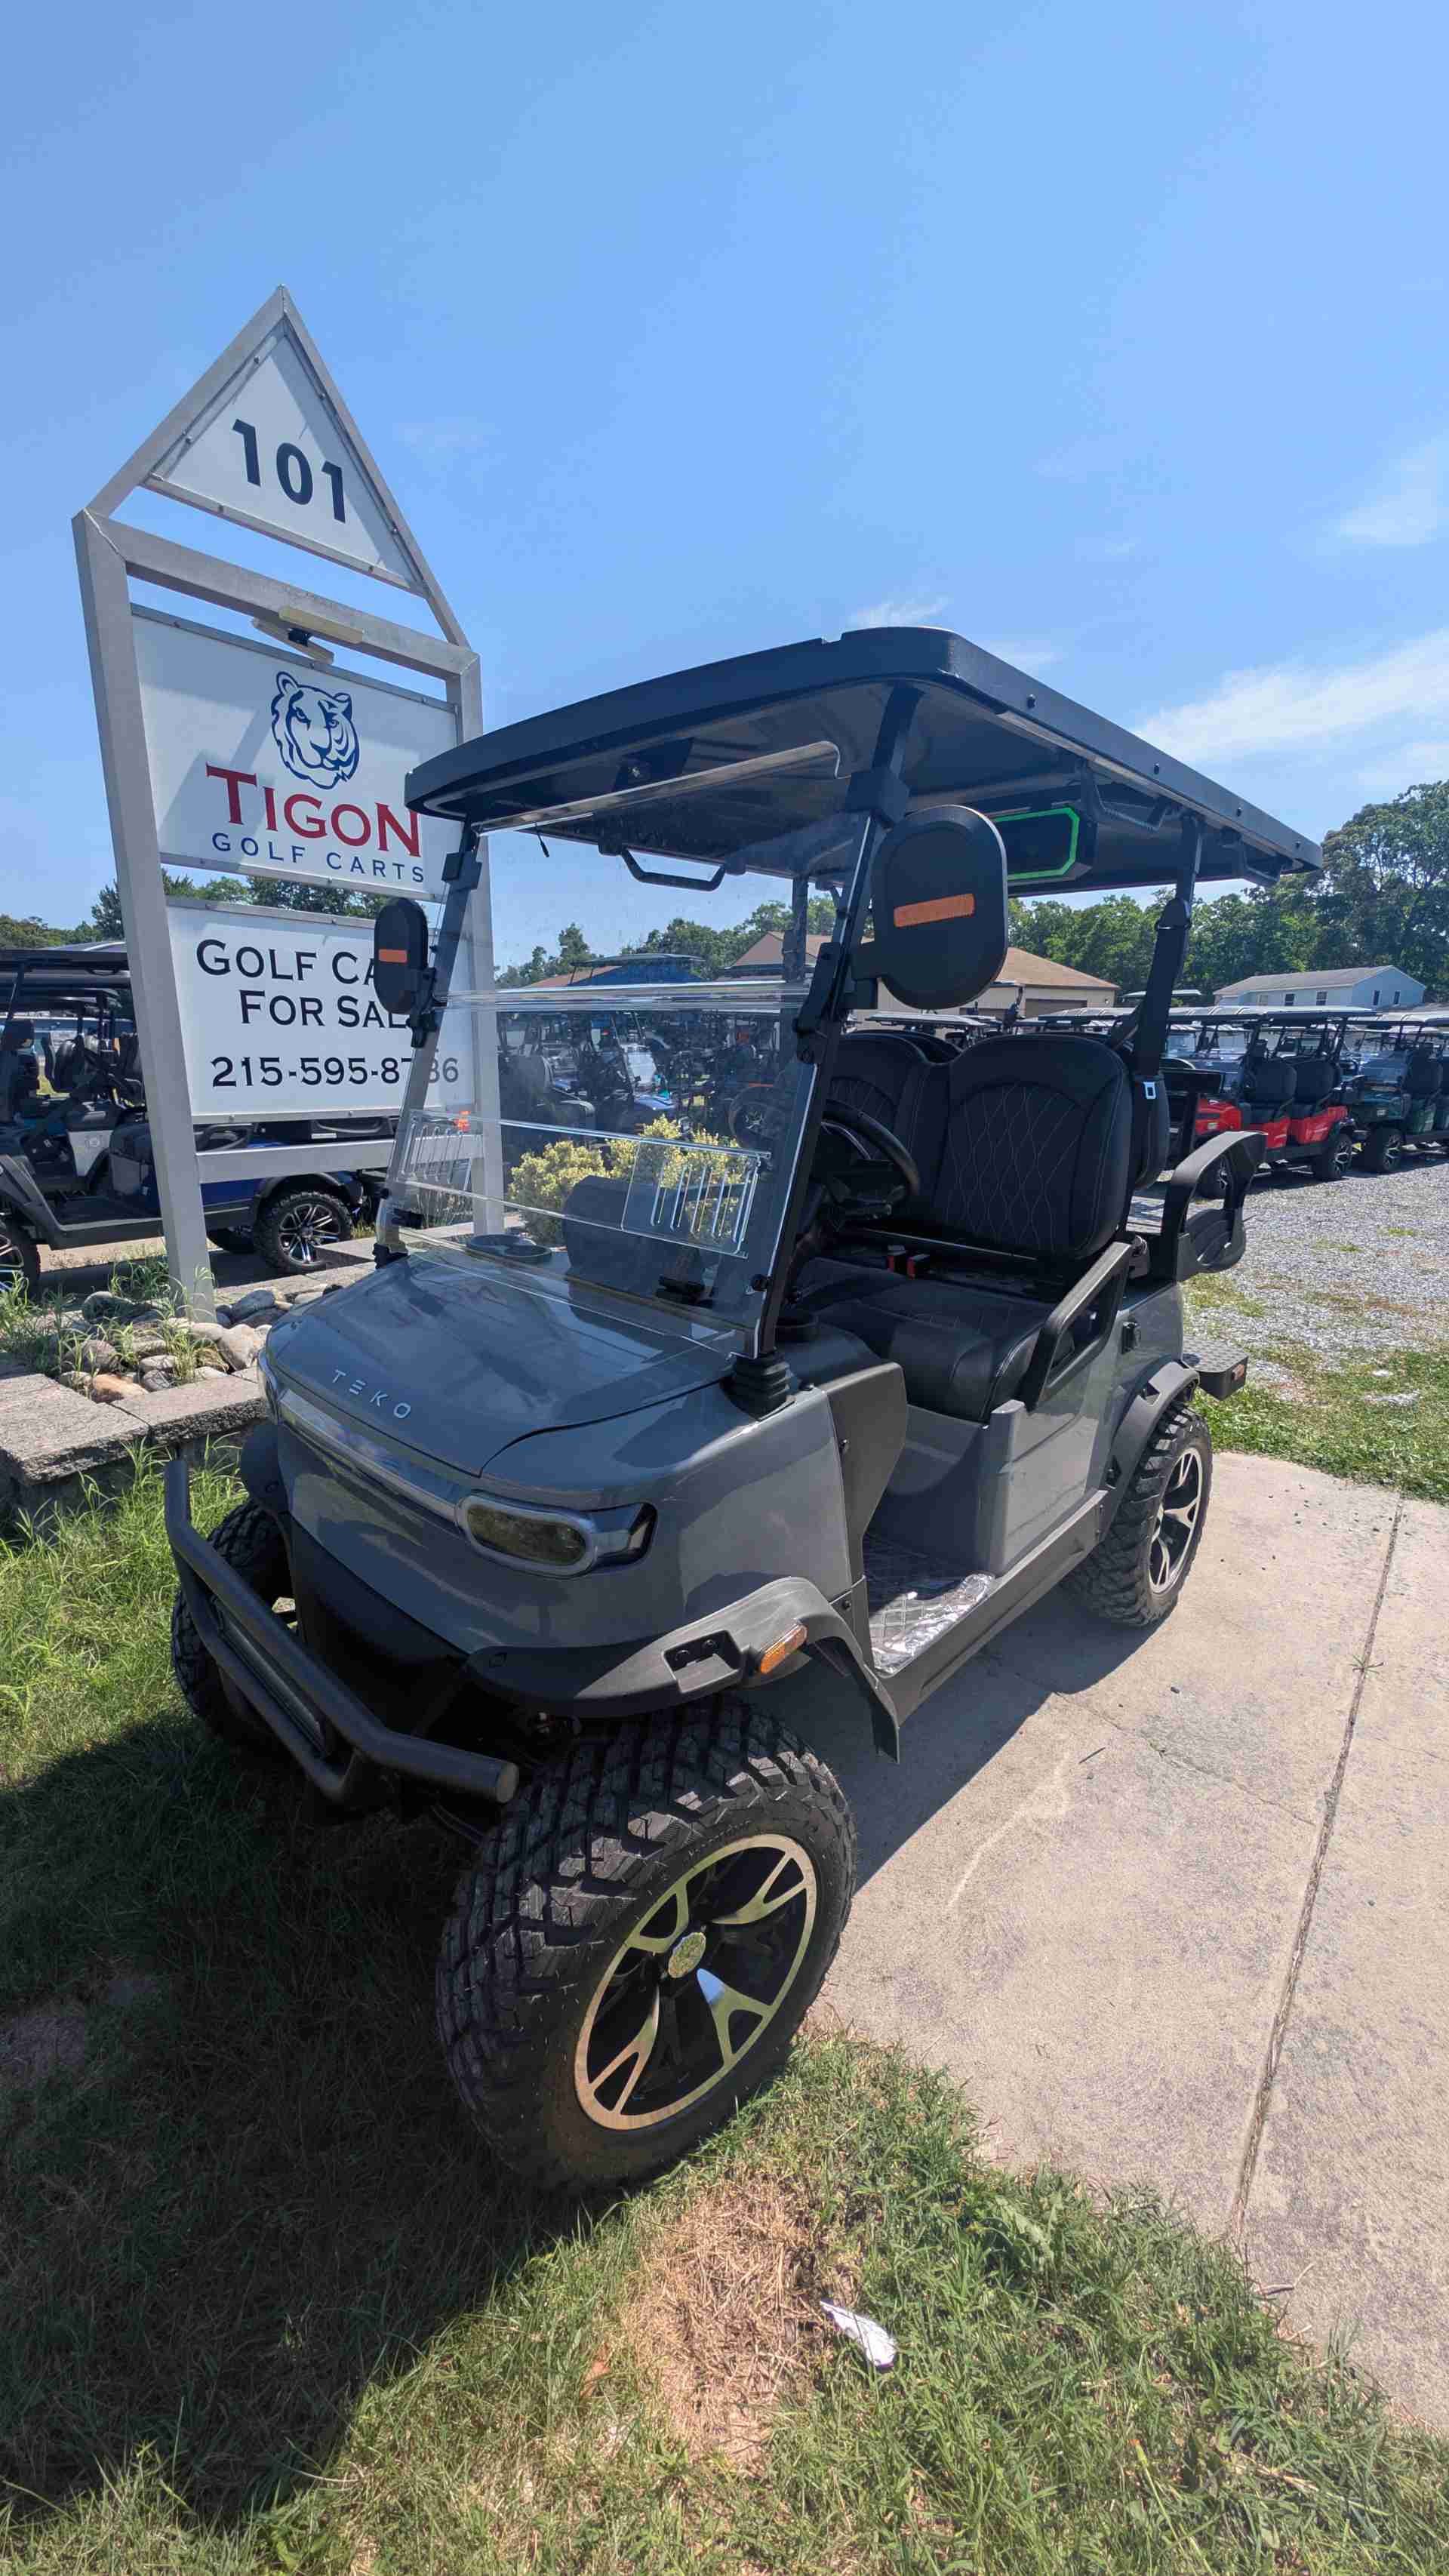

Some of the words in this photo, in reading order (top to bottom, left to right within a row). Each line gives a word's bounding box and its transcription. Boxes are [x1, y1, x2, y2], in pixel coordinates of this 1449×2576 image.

[232, 418, 346, 524] 101
[205, 762, 422, 858] TIGON
[212, 832, 306, 863] GOLF
[326, 852, 424, 883] CARTS
[196, 939, 317, 981] GOLF
[238, 989, 325, 1026] FOR
[337, 995, 408, 1029] SAL
[332, 1369, 411, 1419] TEKO
